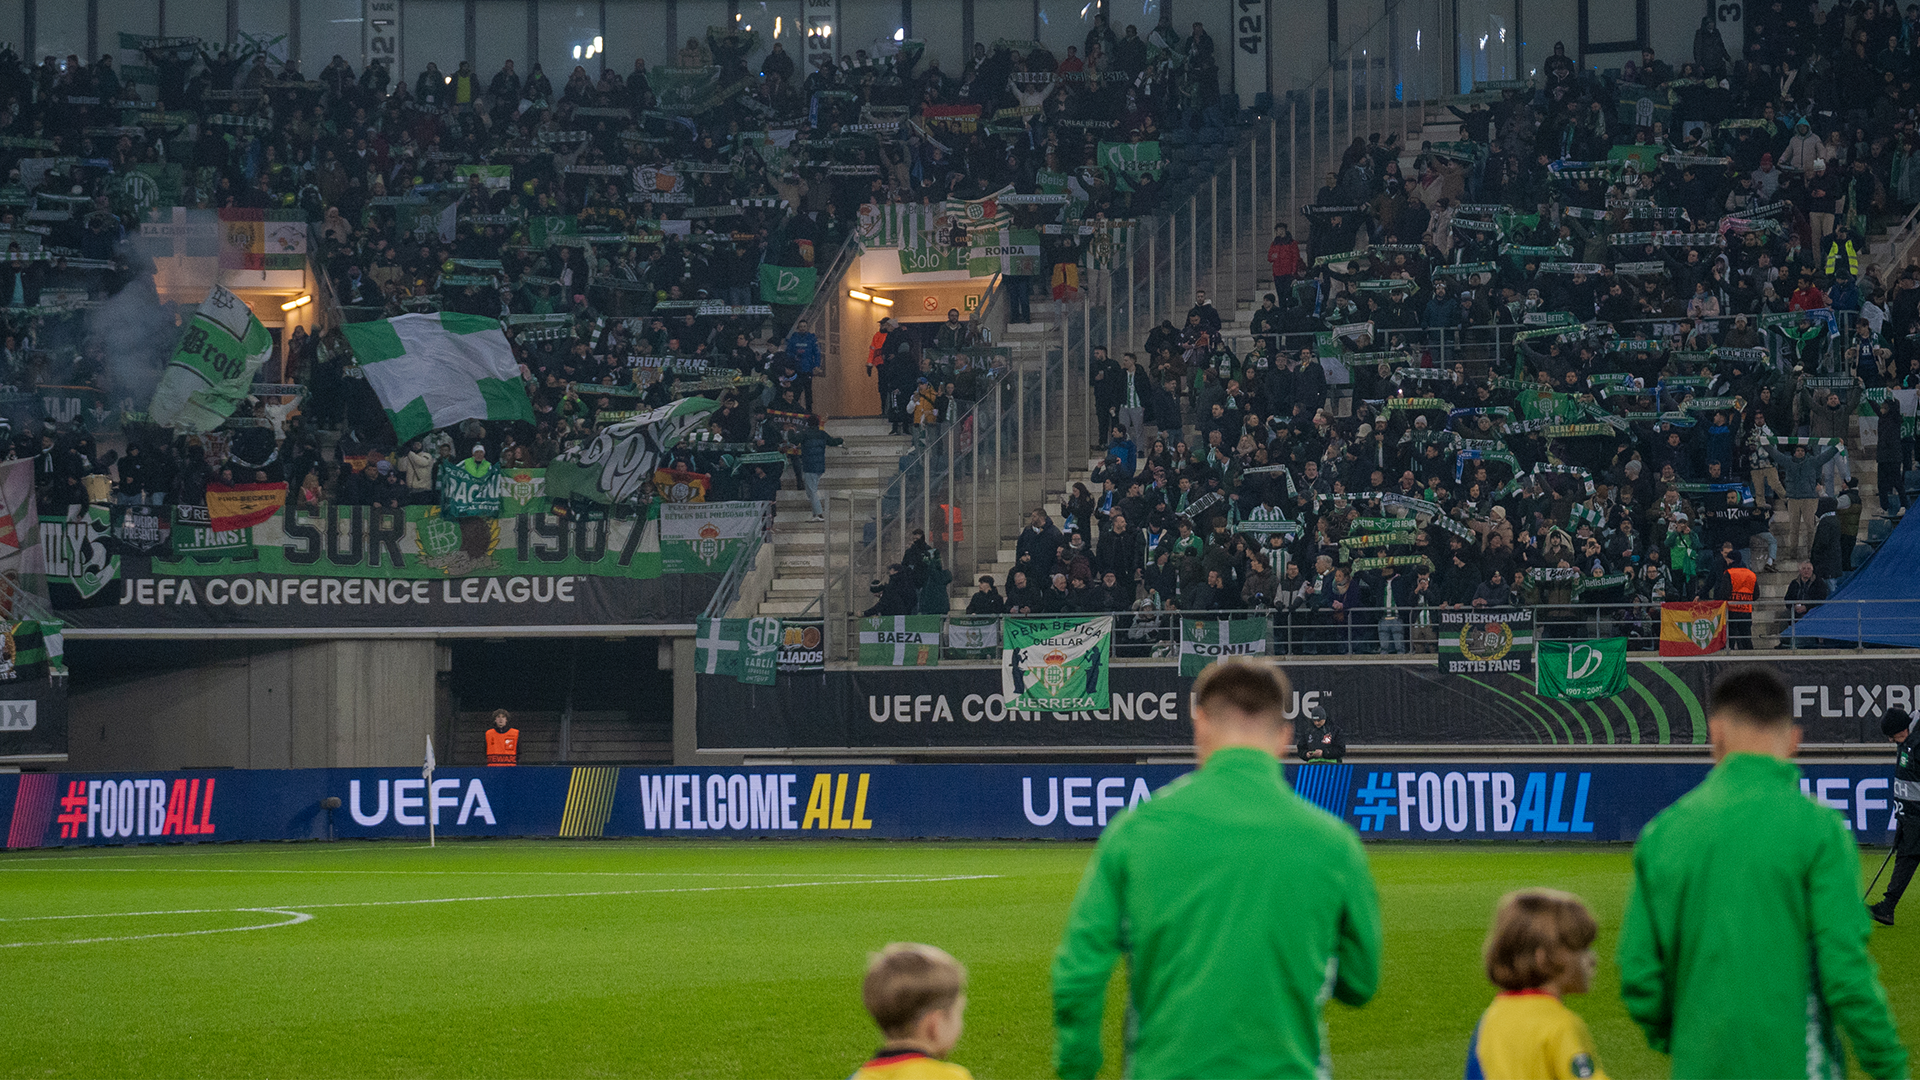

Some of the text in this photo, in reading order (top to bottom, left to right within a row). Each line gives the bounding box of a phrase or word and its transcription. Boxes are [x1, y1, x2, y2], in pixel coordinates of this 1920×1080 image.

[372, 3, 394, 11] VAK
[985, 246, 1024, 256] RONDA
[1652, 321, 1720, 336] FRCE
[1629, 341, 1647, 350] ISCO
[626, 356, 709, 368] PRUNA FANS
[283, 500, 406, 568] SUR
[515, 506, 648, 568] 1907
[206, 577, 429, 605] CONFERENCE
[1442, 610, 1532, 624] DOS HERMANAS
[1011, 622, 1047, 639] PEÑA
[877, 632, 923, 644] BAEZA
[1033, 638, 1083, 647] CUELLAR
[1193, 643, 1256, 656] CONIL
[1449, 659, 1521, 673] BETIS FANS
[1566, 687, 1581, 695] 1907
[869, 693, 954, 722] UEFA
[1015, 697, 1096, 709] HERRERA
[58, 778, 215, 838] #FOOTBALL
[349, 777, 497, 826] UEFA
[640, 773, 873, 830] WELCOME ALL
[1354, 771, 1594, 832] #FOOTBALL
[1800, 777, 1897, 831] EF
